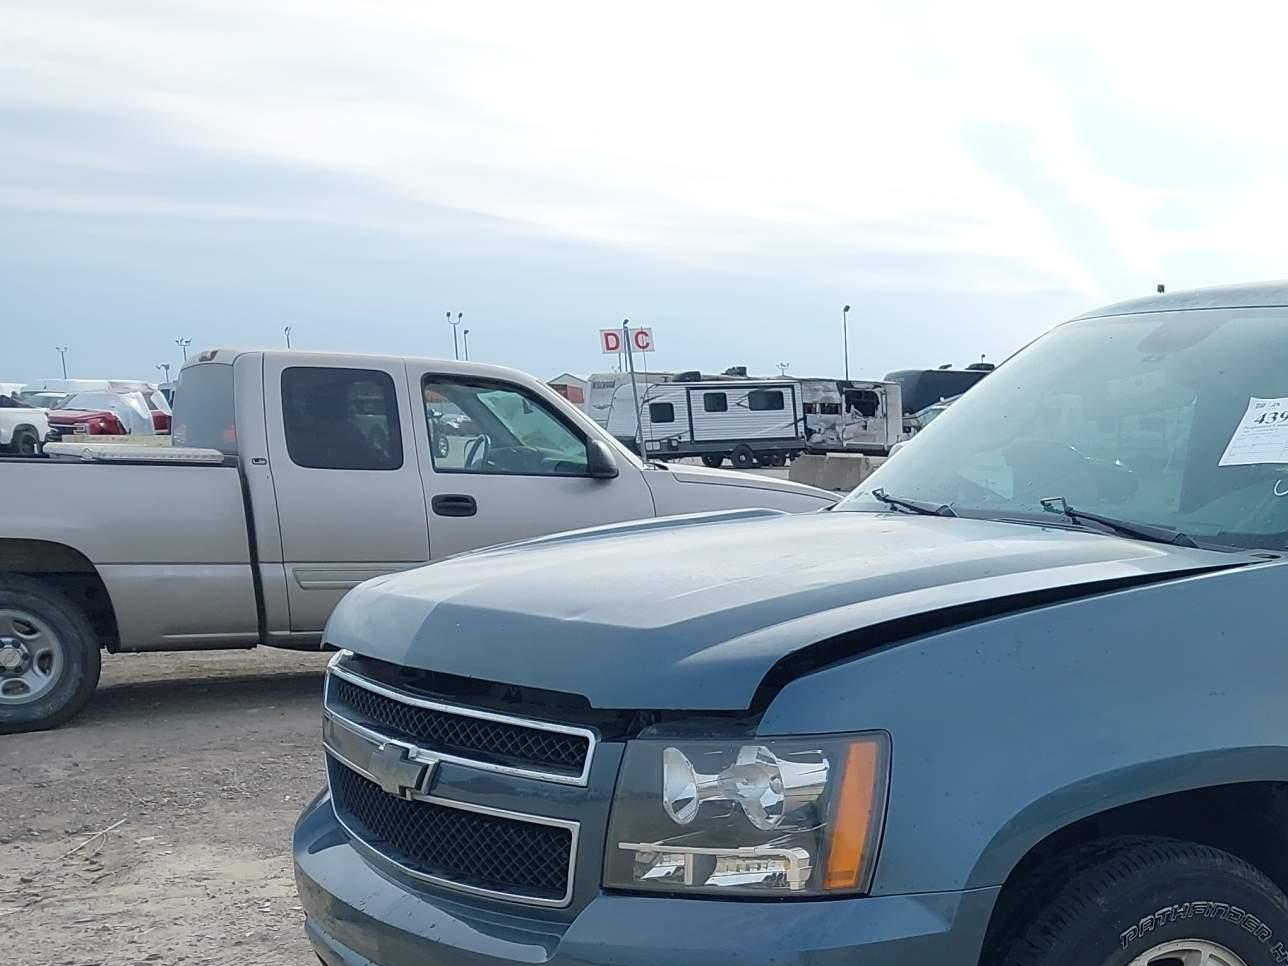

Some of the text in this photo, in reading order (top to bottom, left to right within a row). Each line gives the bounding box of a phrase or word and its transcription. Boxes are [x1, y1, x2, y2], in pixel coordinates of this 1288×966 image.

[603, 331, 650, 351] D C
[1120, 901, 1273, 950] PATHFINDER
